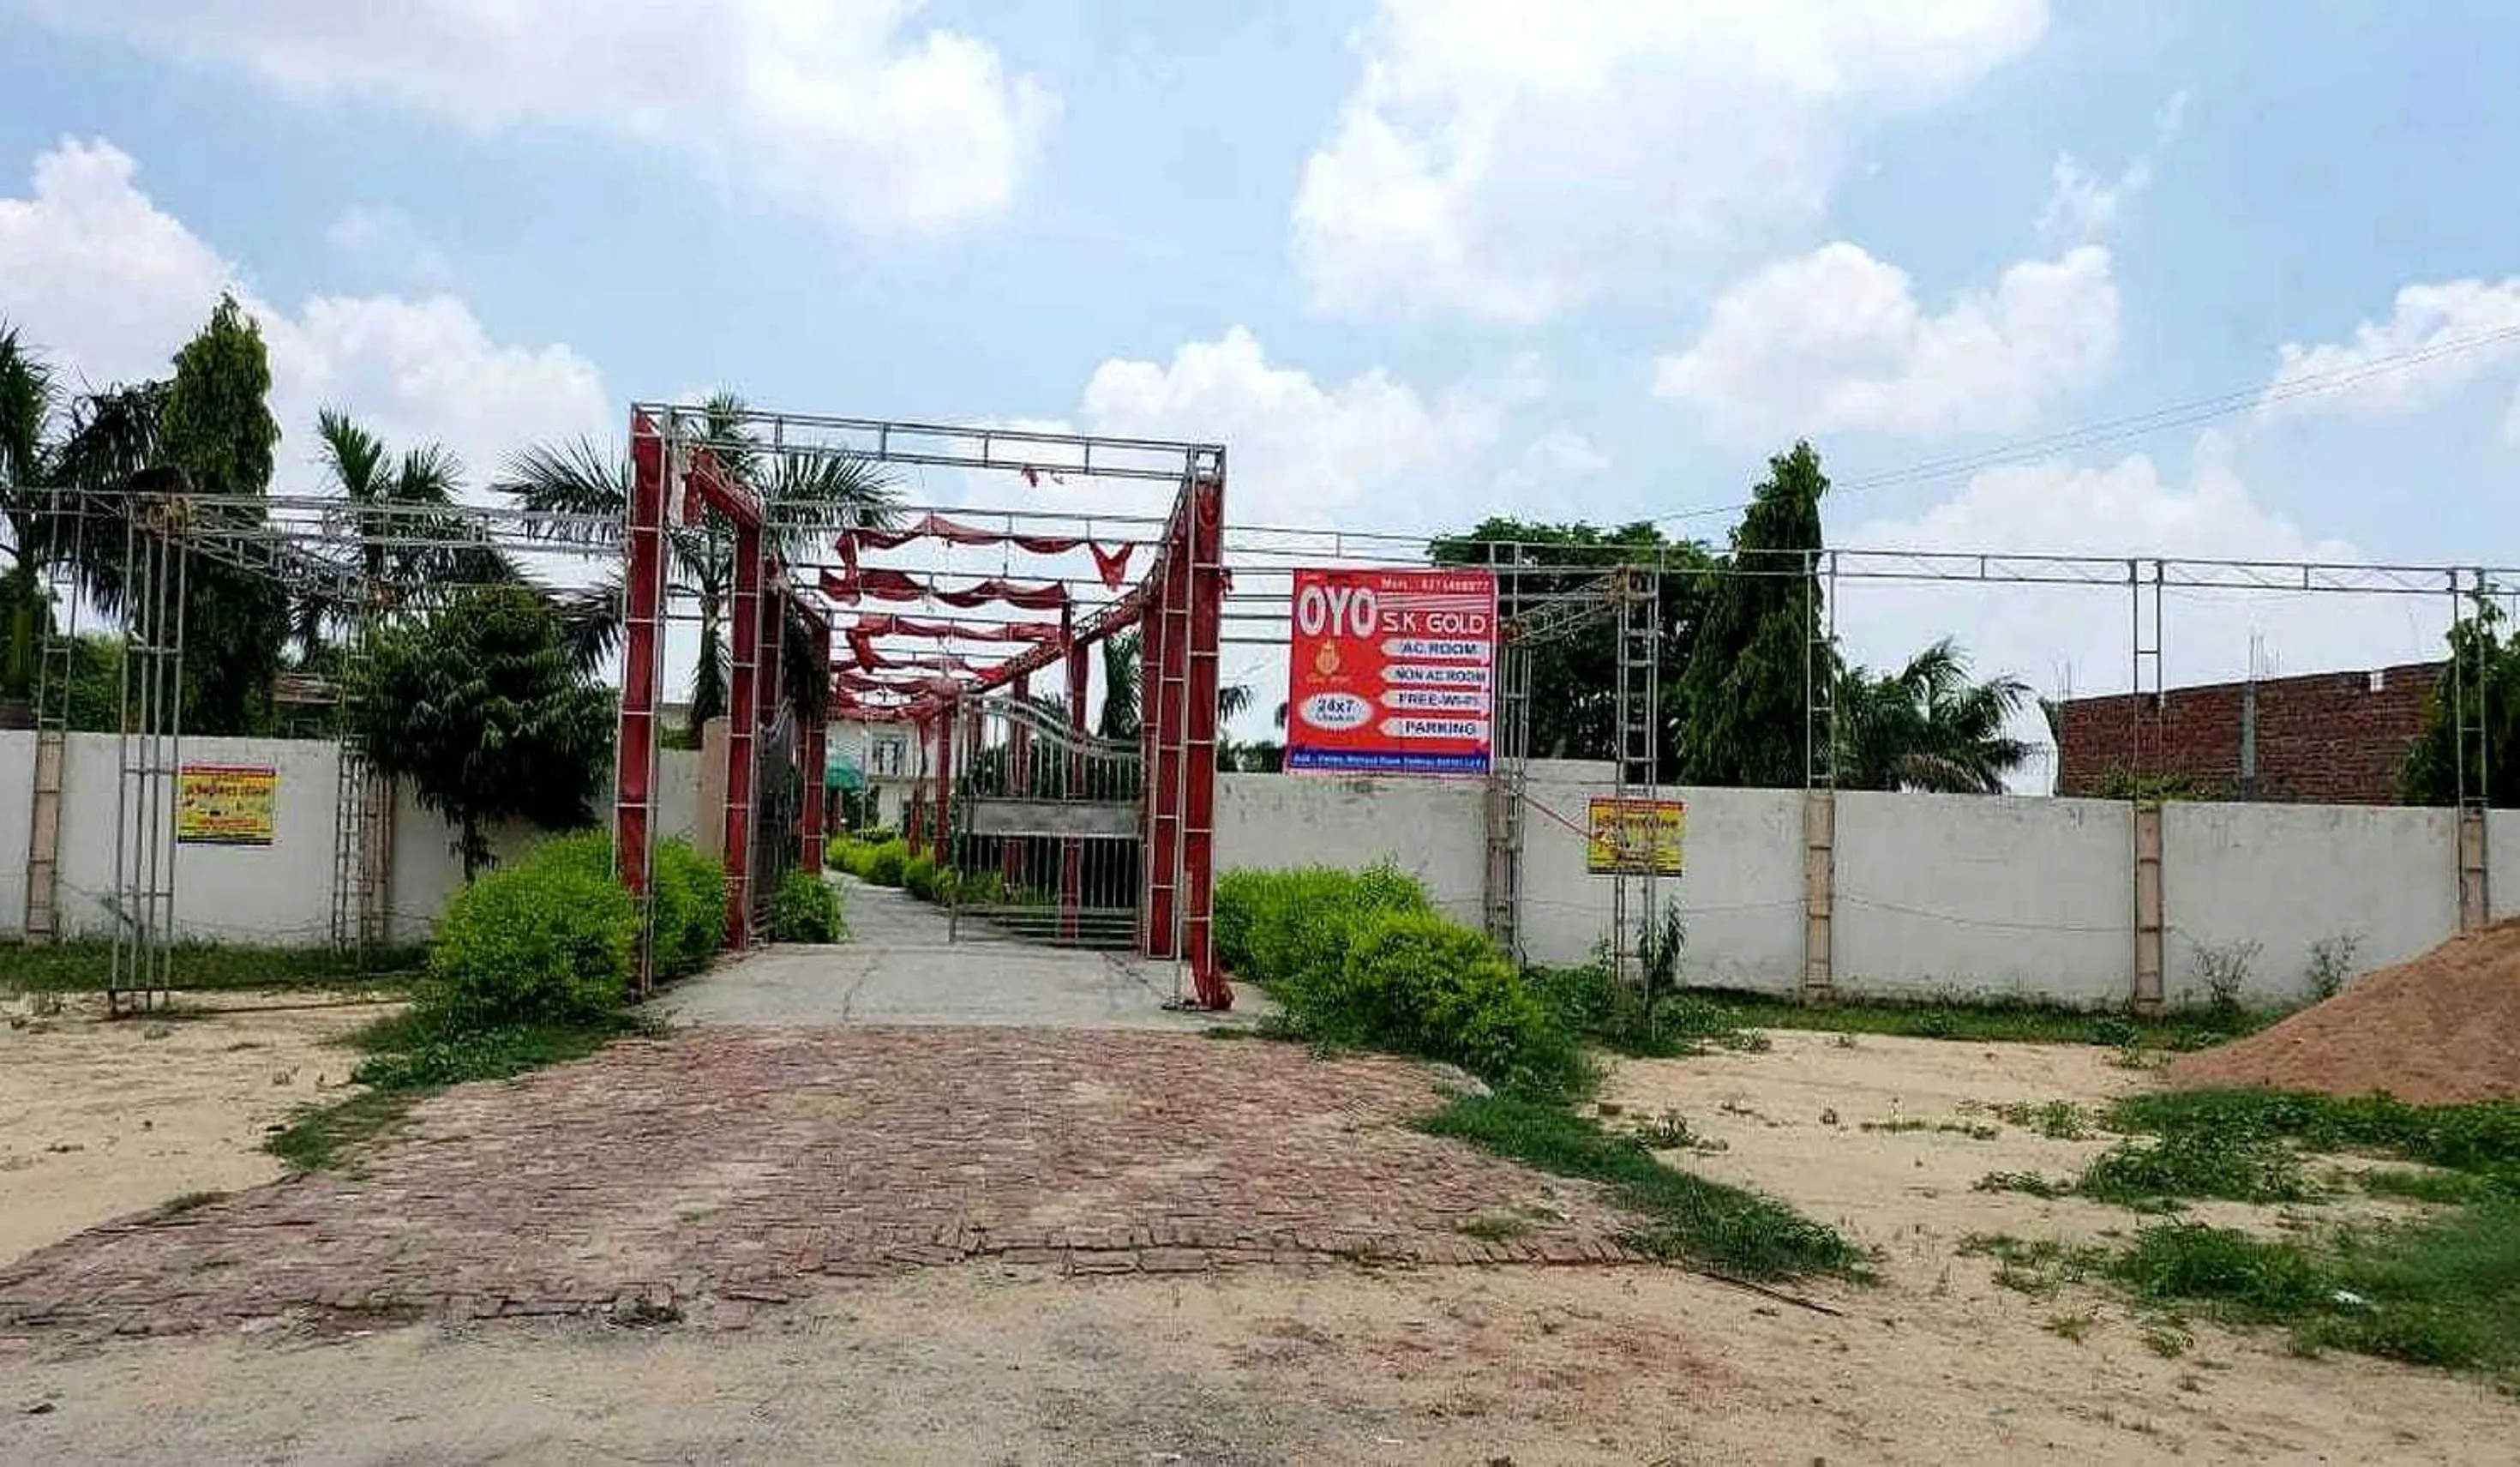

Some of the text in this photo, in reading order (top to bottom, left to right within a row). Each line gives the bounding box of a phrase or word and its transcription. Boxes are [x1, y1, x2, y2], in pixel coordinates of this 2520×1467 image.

[1299, 584, 1377, 637] OYO
[1426, 613, 1486, 634] GOLD
[1429, 643, 1477, 654] ROOM
[1395, 668, 1423, 680] NON
[1406, 721, 1476, 735] PARKING
